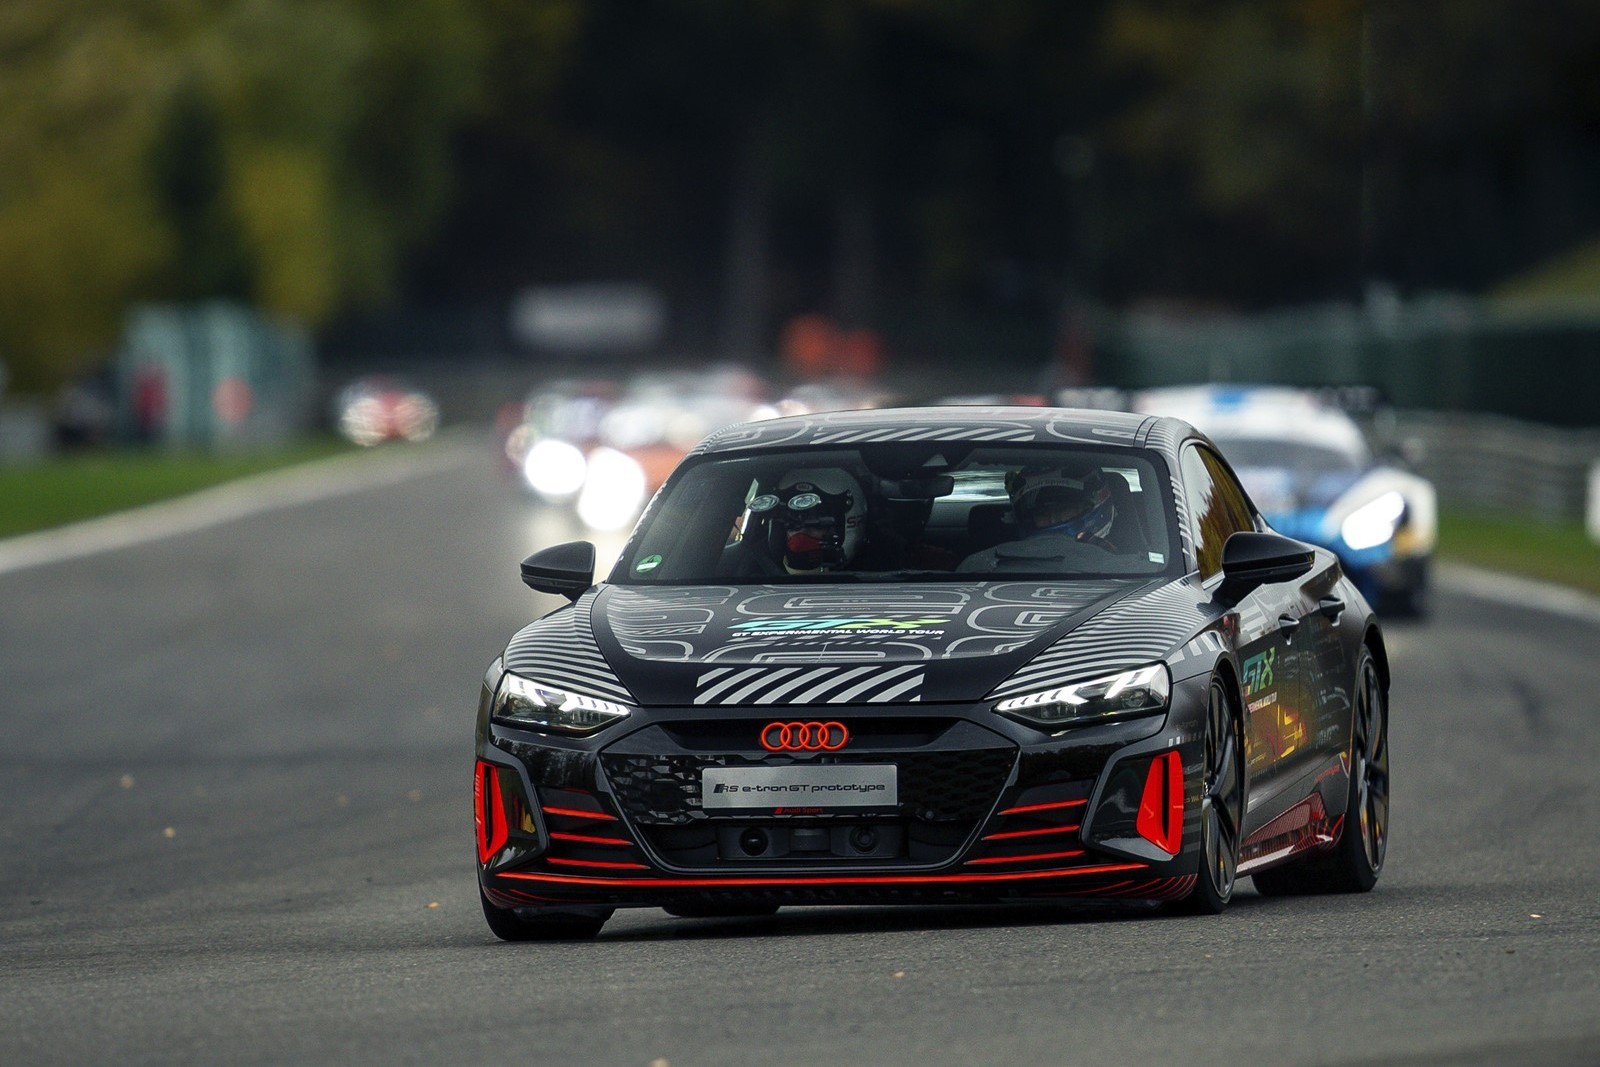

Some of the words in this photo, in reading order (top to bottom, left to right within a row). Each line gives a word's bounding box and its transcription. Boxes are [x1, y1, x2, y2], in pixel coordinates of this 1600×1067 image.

[750, 629, 853, 637] EXPERIMENTAL
[742, 783, 787, 792] e-tron
[811, 783, 886, 793] prototype
